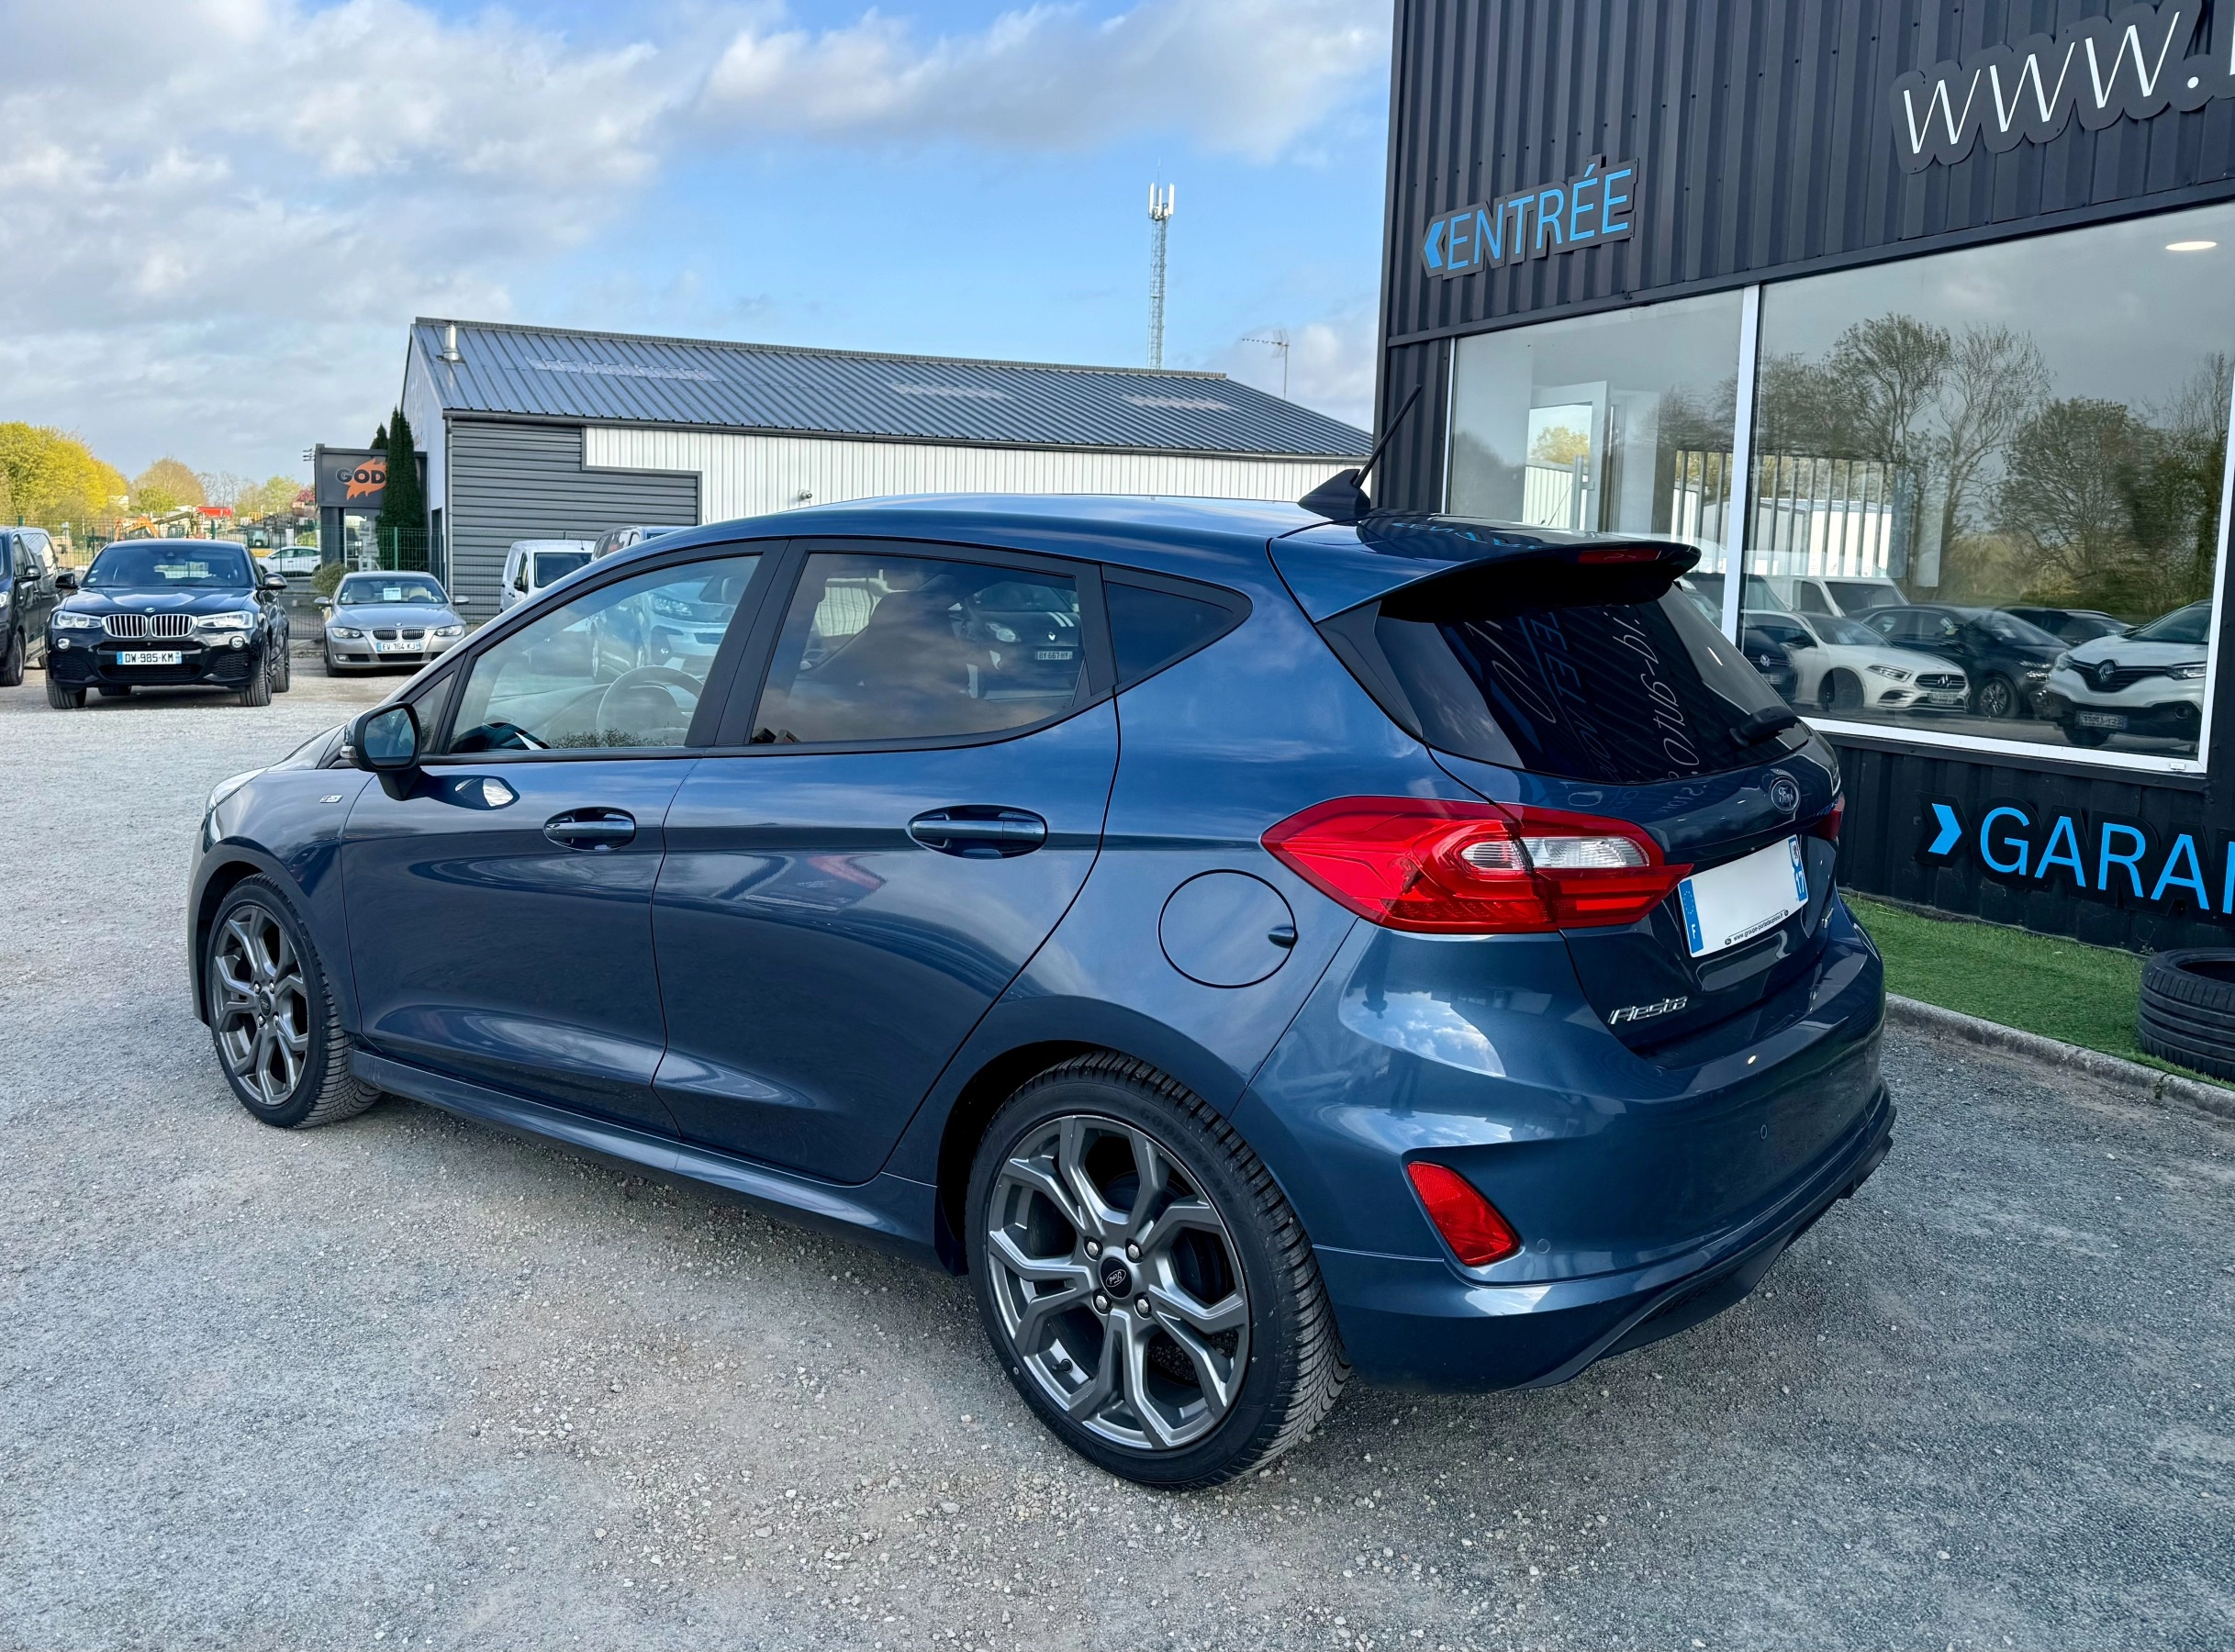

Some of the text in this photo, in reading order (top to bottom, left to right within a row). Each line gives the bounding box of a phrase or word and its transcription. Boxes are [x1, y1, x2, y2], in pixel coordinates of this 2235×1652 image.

[1448, 163, 1632, 271] ENTRÉE
[125, 653, 173, 663] DW-985-KM
[1607, 996, 1688, 1024] Fiesta
